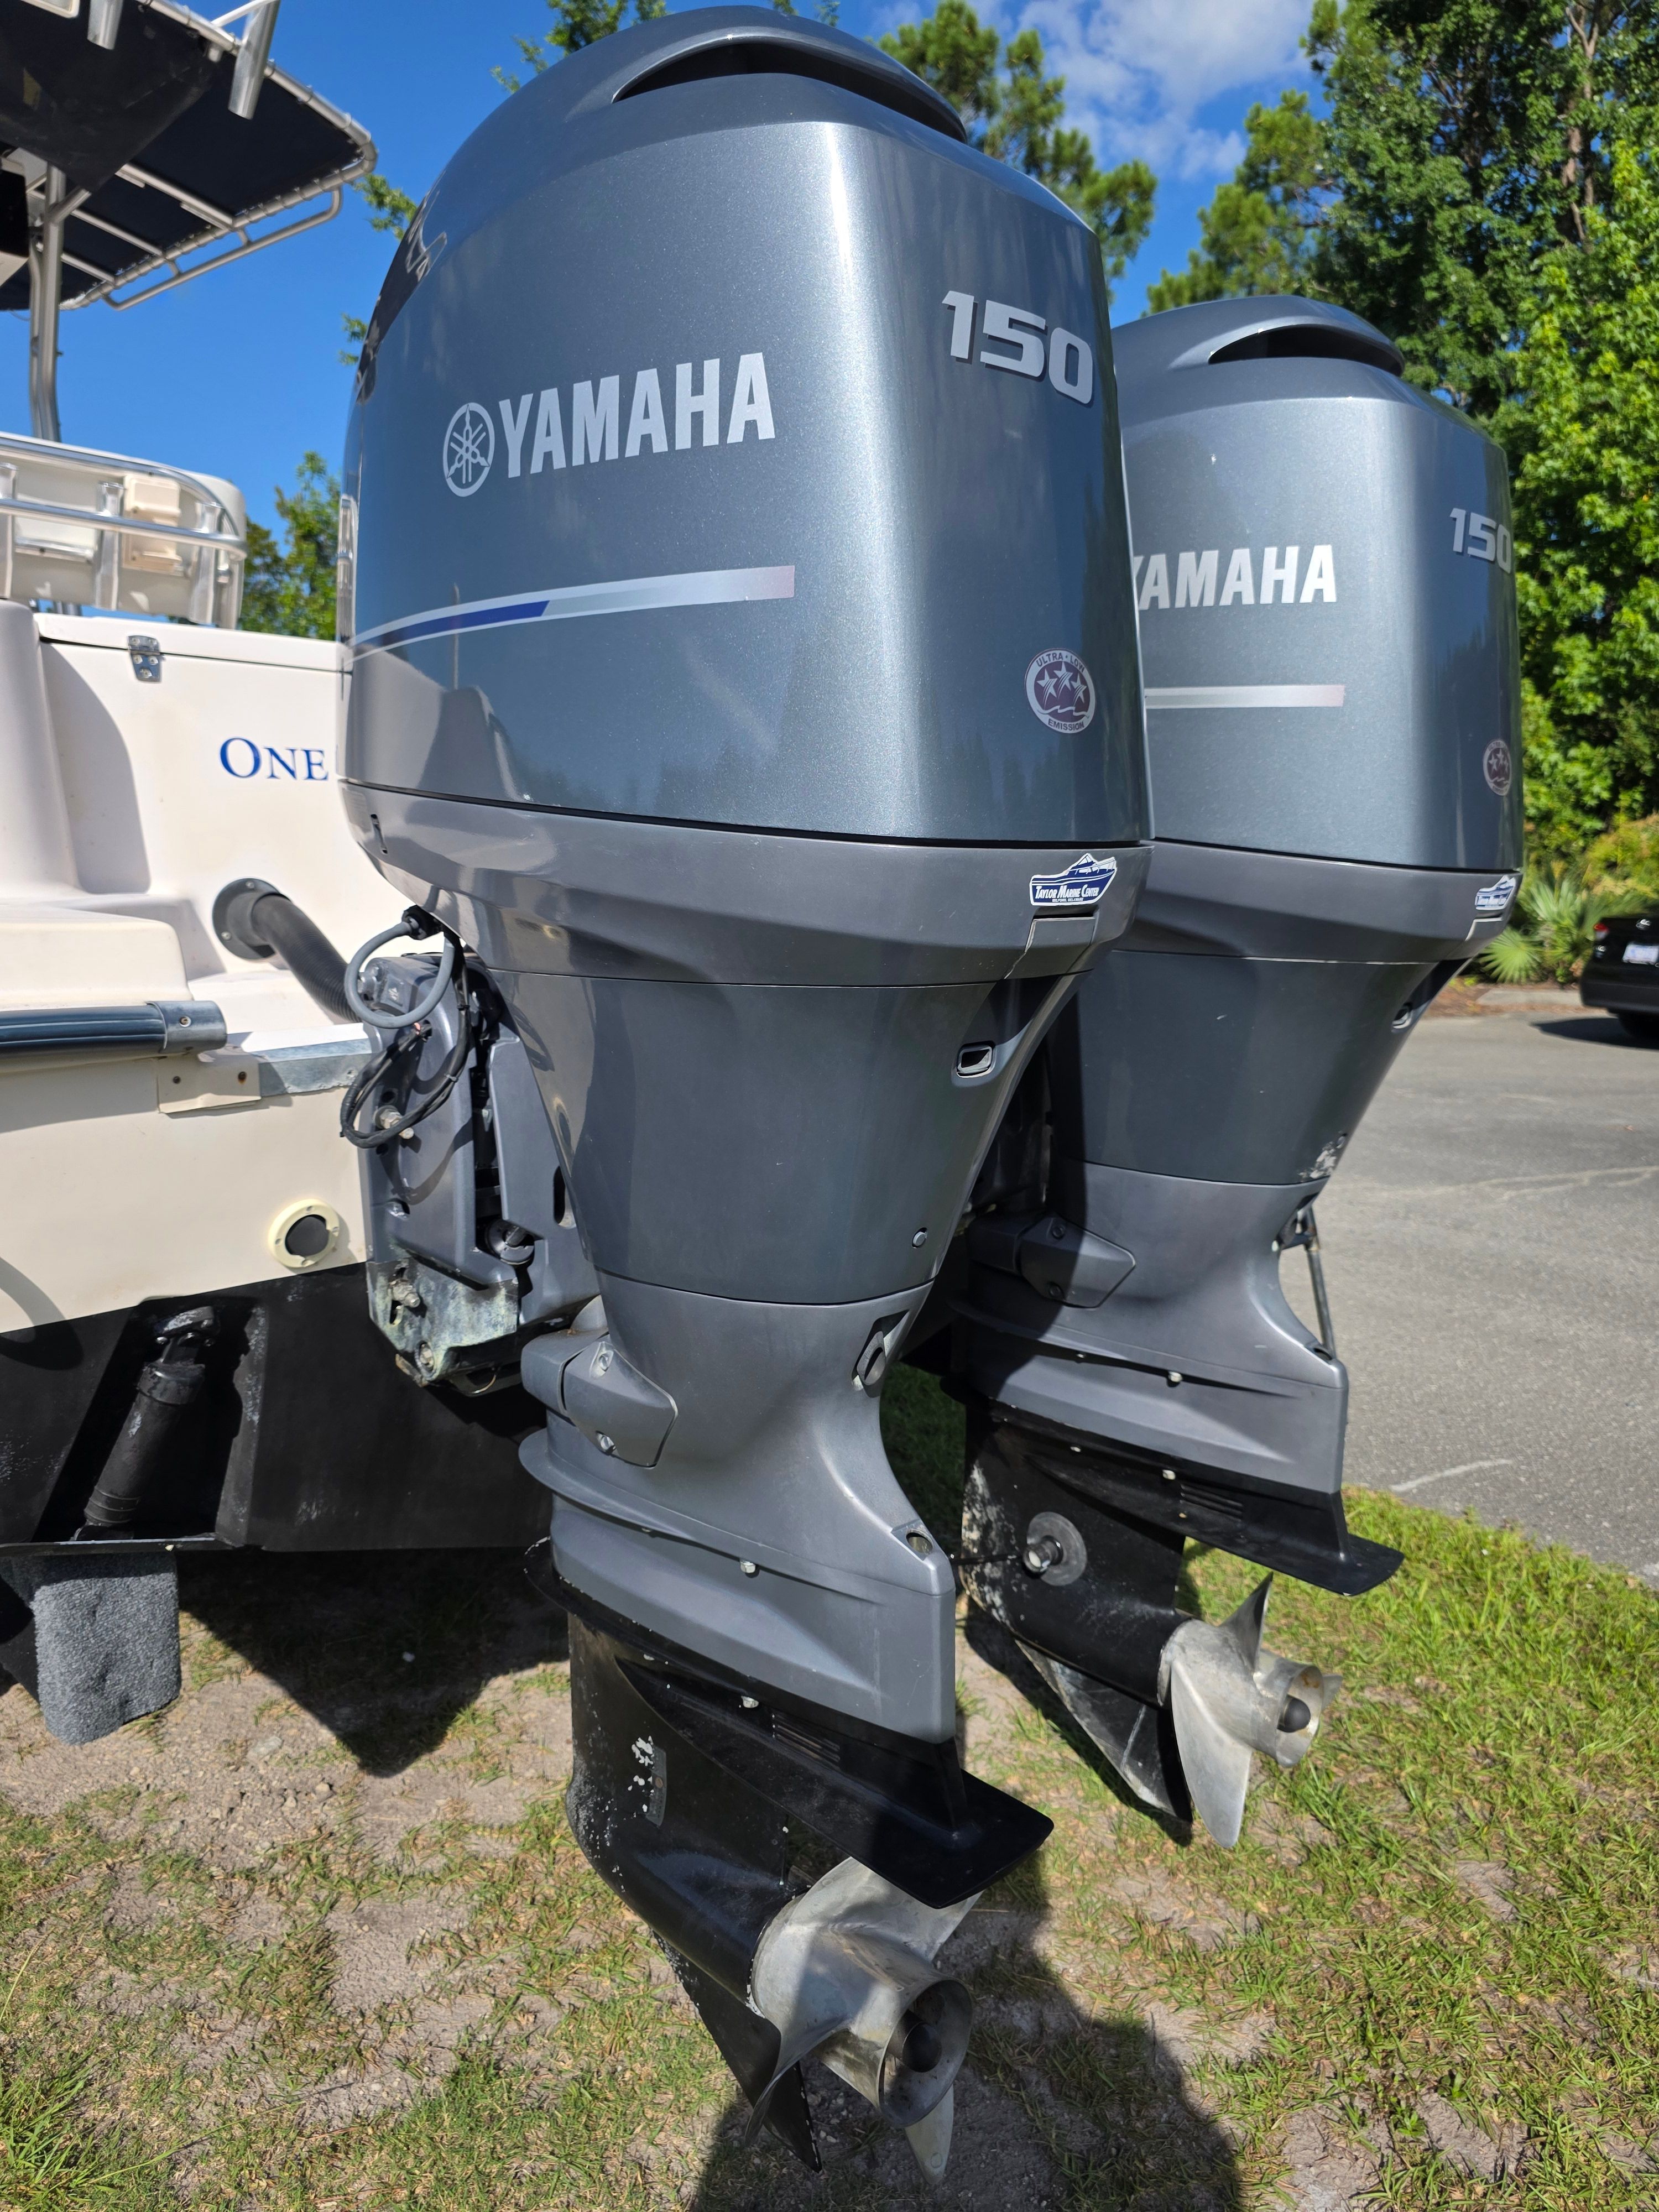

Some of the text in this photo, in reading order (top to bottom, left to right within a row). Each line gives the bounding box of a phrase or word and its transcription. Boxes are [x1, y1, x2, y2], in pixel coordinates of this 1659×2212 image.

[942, 290, 1093, 405] 150
[499, 352, 775, 478] YAMAHA
[1449, 508, 1512, 574] 150
[1048, 718, 1084, 731] EMISSION
[220, 737, 329, 781] ONE
[1035, 884, 1100, 899] TAYLOR MARINE CENTER
